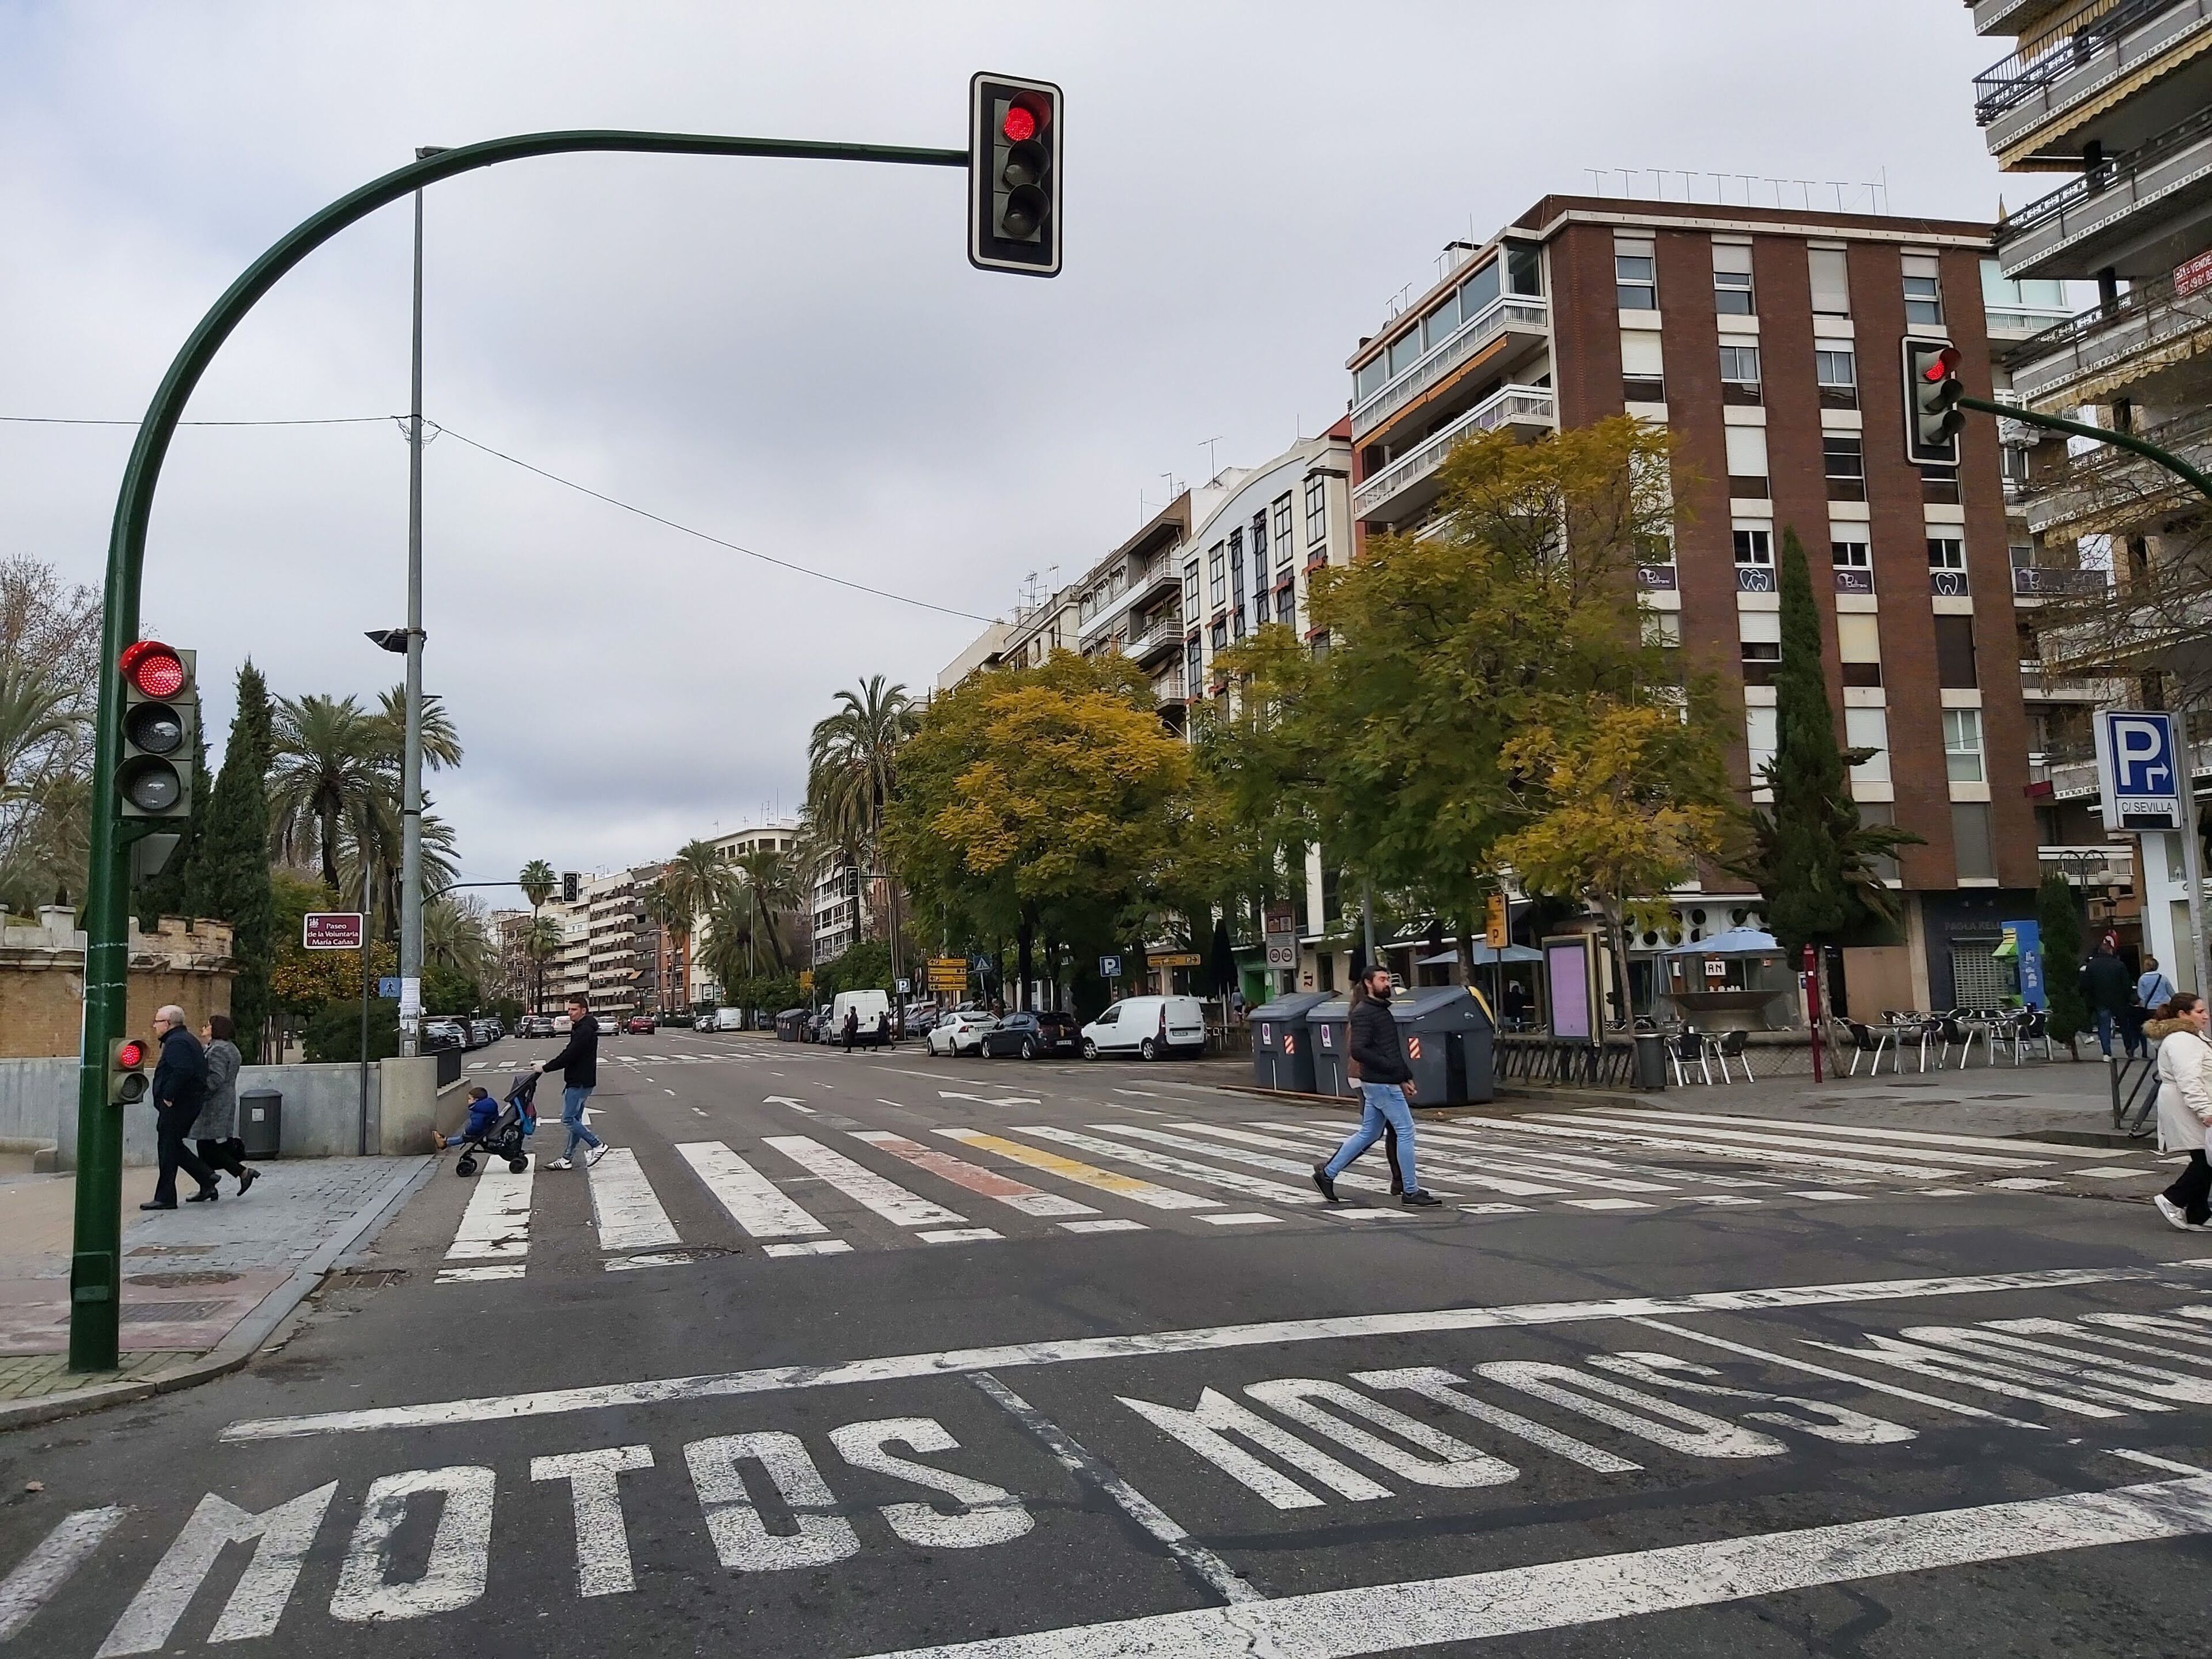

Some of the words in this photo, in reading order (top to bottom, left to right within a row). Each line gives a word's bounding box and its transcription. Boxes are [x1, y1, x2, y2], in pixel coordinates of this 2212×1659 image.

[2190, 255, 2212, 273] VENDE
[2115, 721, 2161, 786] P
[2122, 802, 2131, 812] C/
[2134, 802, 2173, 812] SEVILLA
[1493, 929, 1498, 944] P
[1104, 959, 1116, 974] P
[899, 980, 907, 991] P
[1791, 1304, 2212, 1418] MOT
[1112, 1351, 1921, 1510] MOTOS
[92, 1416, 1036, 1659] MOTOS
